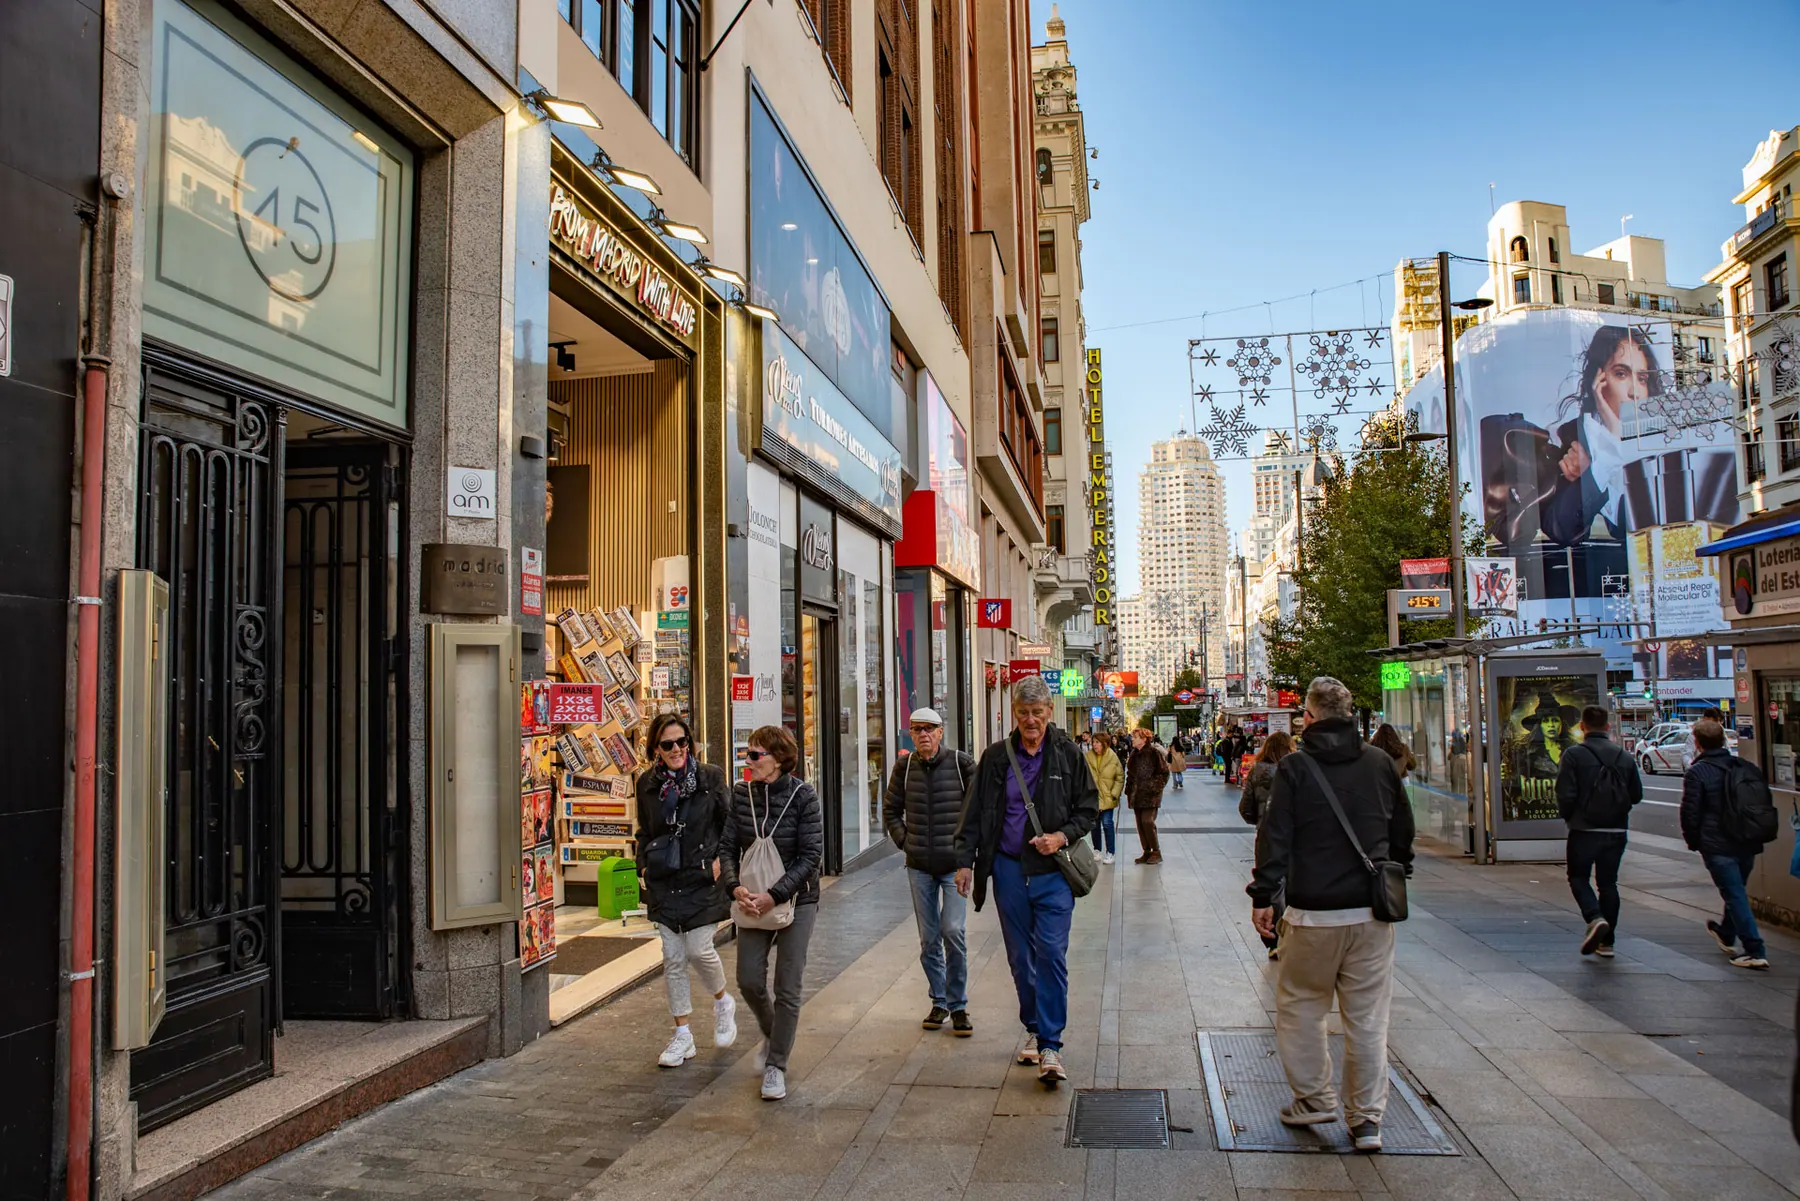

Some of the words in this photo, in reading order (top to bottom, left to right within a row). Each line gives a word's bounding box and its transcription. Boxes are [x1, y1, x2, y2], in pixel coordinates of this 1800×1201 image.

[253, 186, 323, 265] 15
[549, 181, 591, 259] FROM
[590, 219, 642, 288] MADRID
[639, 259, 670, 320] WITH
[668, 284, 696, 338] LOVE
[1087, 349, 1103, 443] HOTEL
[810, 396, 849, 449] TURRONES
[847, 431, 880, 476] ARTESANOS
[1091, 454, 1111, 626] EMPERADOR
[443, 557, 505, 576] madrid
[1761, 573, 1778, 594] del
[1407, 595, 1440, 608] +15°C
[556, 695, 594, 705] 1X3€
[560, 687, 593, 695] IMANES
[1655, 686, 1694, 695] antander
[553, 713, 599, 722] 5X10€
[555, 705, 596, 713] 2X5€
[562, 742, 580, 769] MADRID
[582, 779, 610, 792] ESPAÑA
